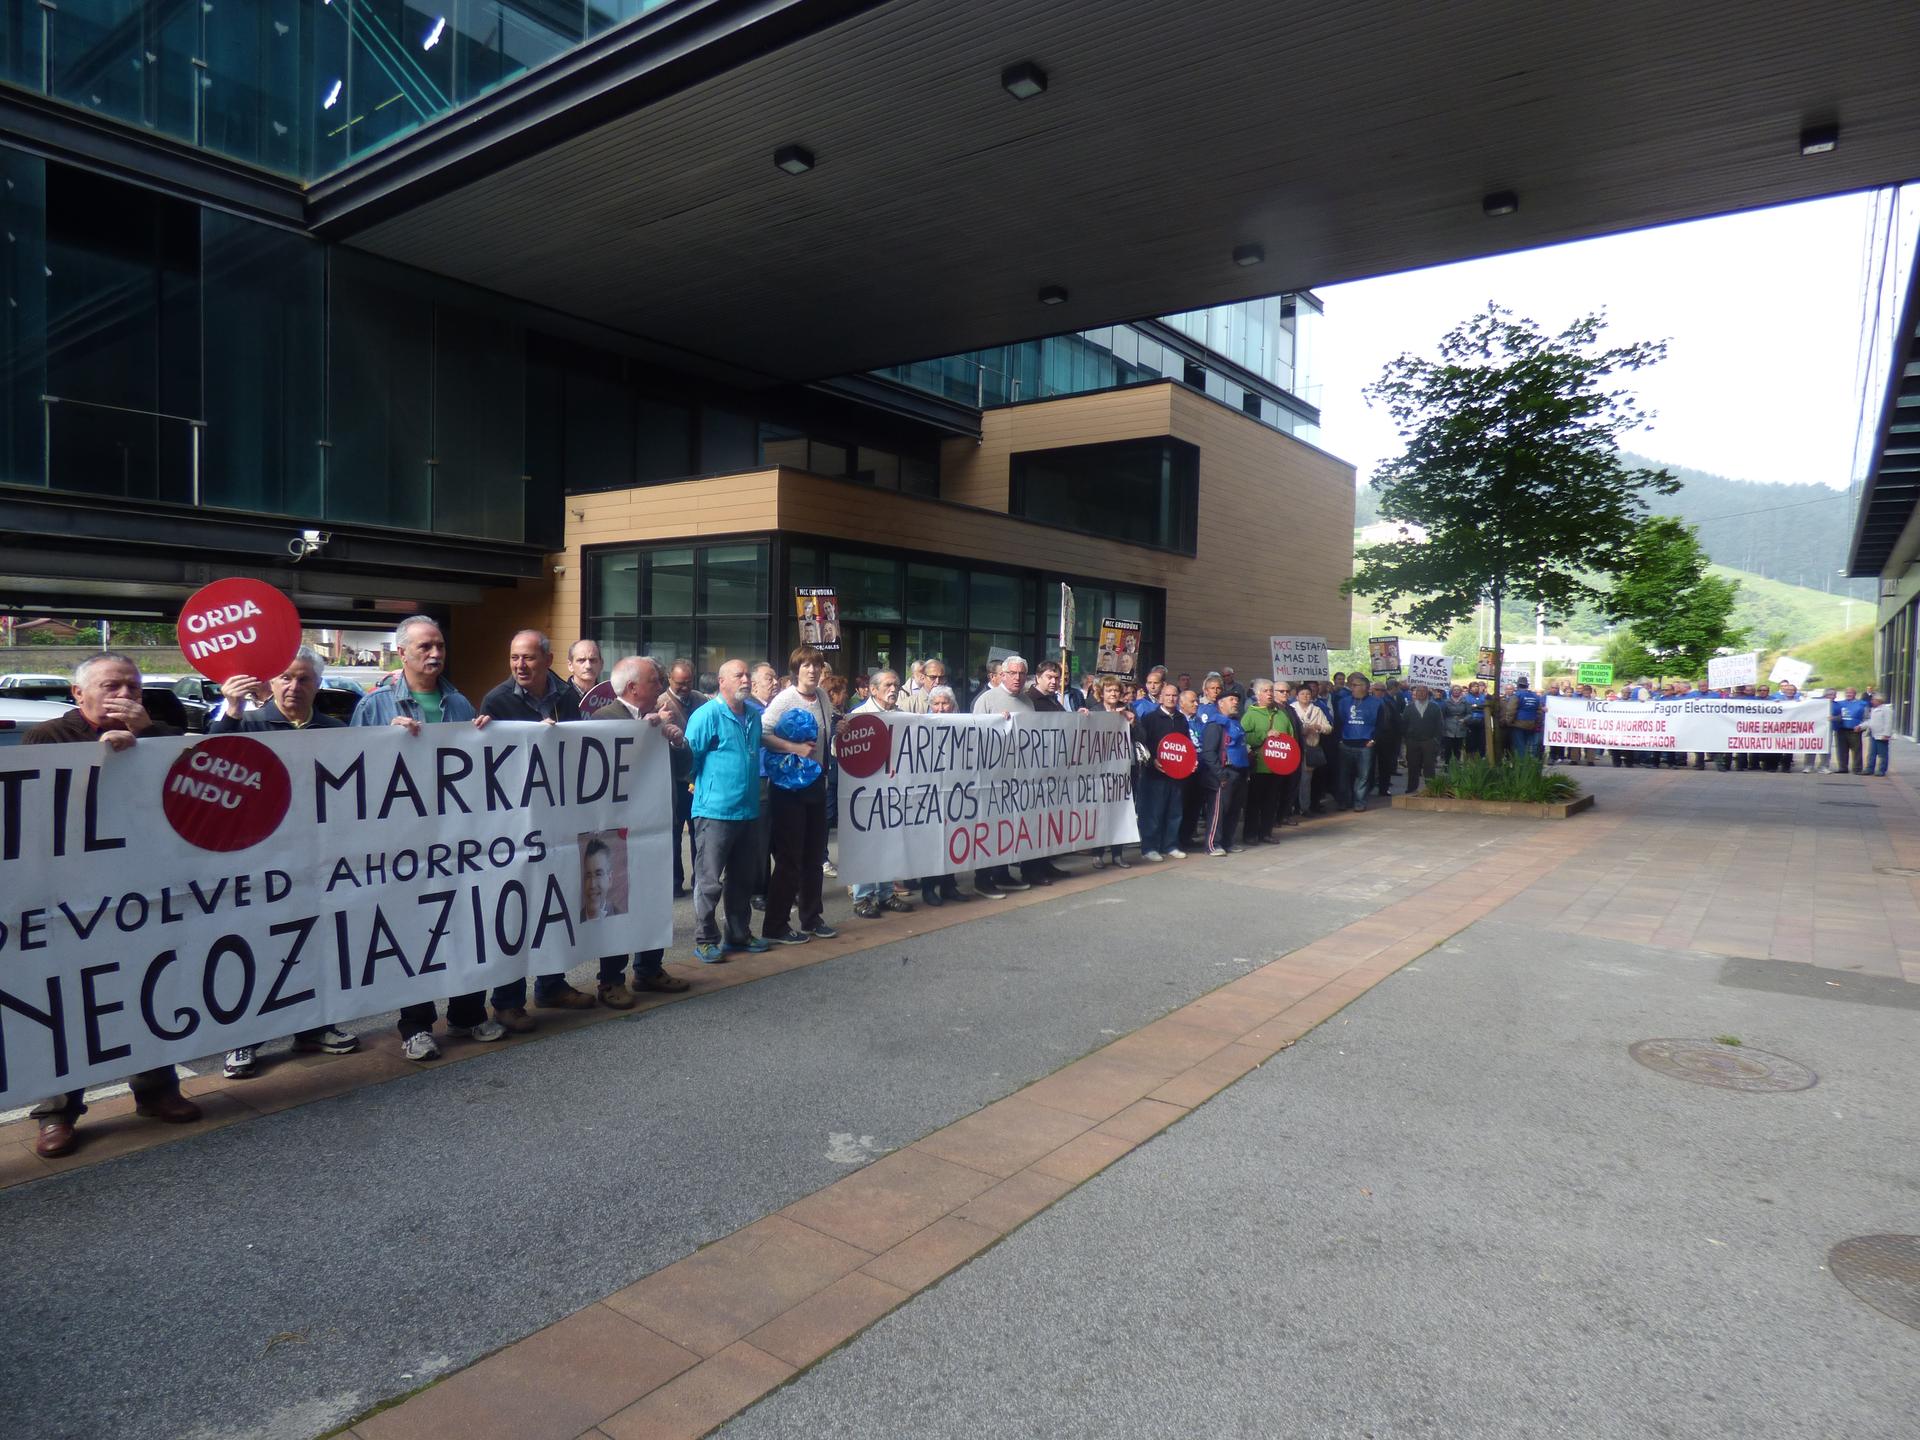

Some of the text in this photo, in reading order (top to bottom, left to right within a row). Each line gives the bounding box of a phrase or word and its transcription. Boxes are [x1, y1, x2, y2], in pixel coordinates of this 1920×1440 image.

[187, 600, 262, 633] ORDA
[190, 626, 257, 659] INDU
[1274, 640, 1328, 651] MCC ESTAFA
[1274, 653, 1320, 664] A MAS DE
[1558, 717, 1666, 732] DEVUELVE LOS AHORROS DE
[1736, 721, 1815, 734] GURE EKARPENAK
[842, 726, 876, 743] ORDA
[1548, 732, 1562, 742] LOS
[1565, 732, 1606, 745] JUBILADOS
[841, 742, 871, 758] INDU
[1163, 741, 1187, 753] ORDA
[1267, 740, 1291, 751] ORDA
[1775, 738, 1796, 750] NAHI
[1799, 738, 1823, 750] DUGU
[1161, 751, 1183, 762] INDU
[1265, 749, 1287, 760] INDU
[190, 751, 262, 791] ORDA
[314, 736, 635, 823] MARKAIDE
[171, 774, 242, 809] INDU
[948, 781, 978, 822] OS
[988, 776, 1071, 817] ARROJARIA
[1077, 774, 1097, 803] DEL
[1100, 772, 1131, 803] TEMPLO
[326, 830, 547, 892] AHORROS
